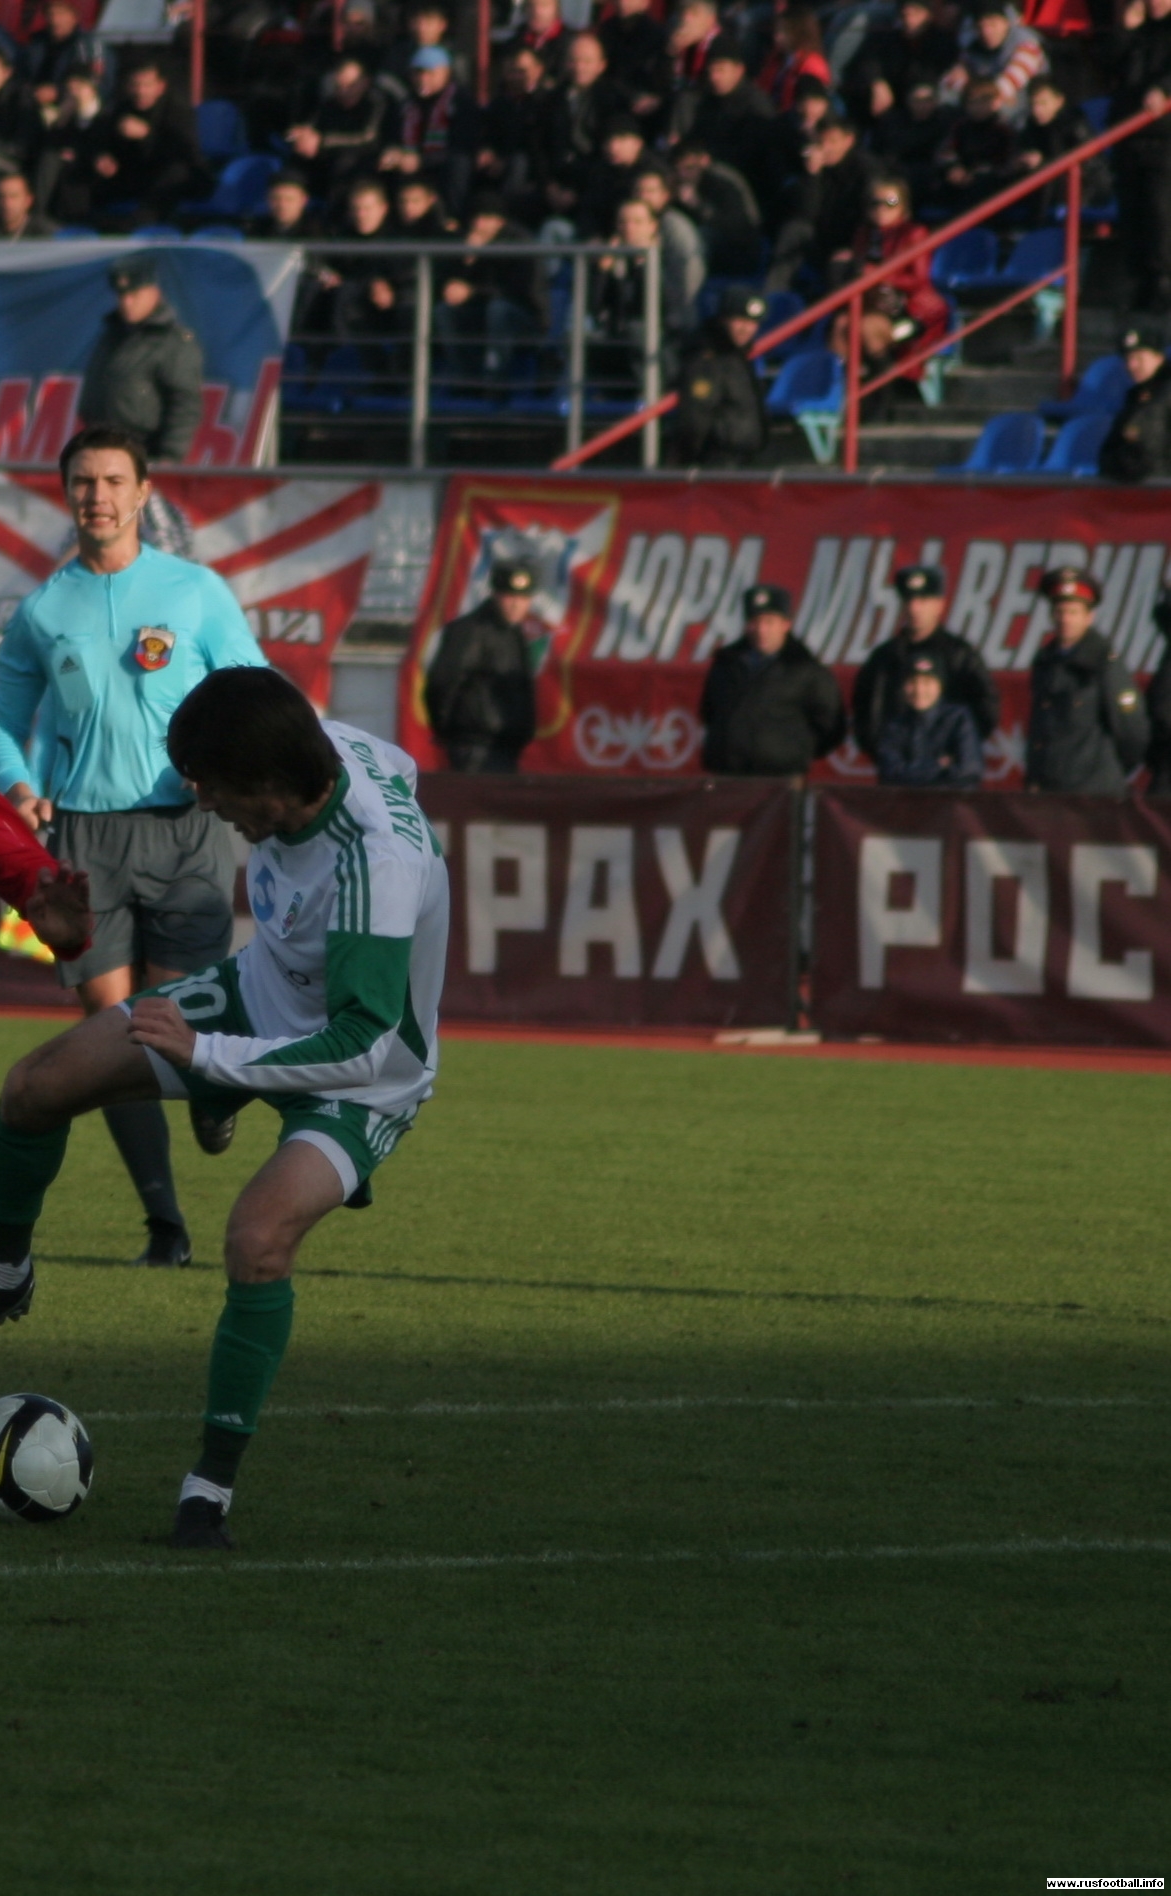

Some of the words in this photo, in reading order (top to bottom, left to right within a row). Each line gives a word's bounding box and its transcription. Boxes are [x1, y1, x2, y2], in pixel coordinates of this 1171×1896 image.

[592, 530, 766, 664] ЮРА
[791, 535, 944, 665] МЫ
[858, 836, 1157, 1000] РОС
[157, 966, 227, 1020] 10
